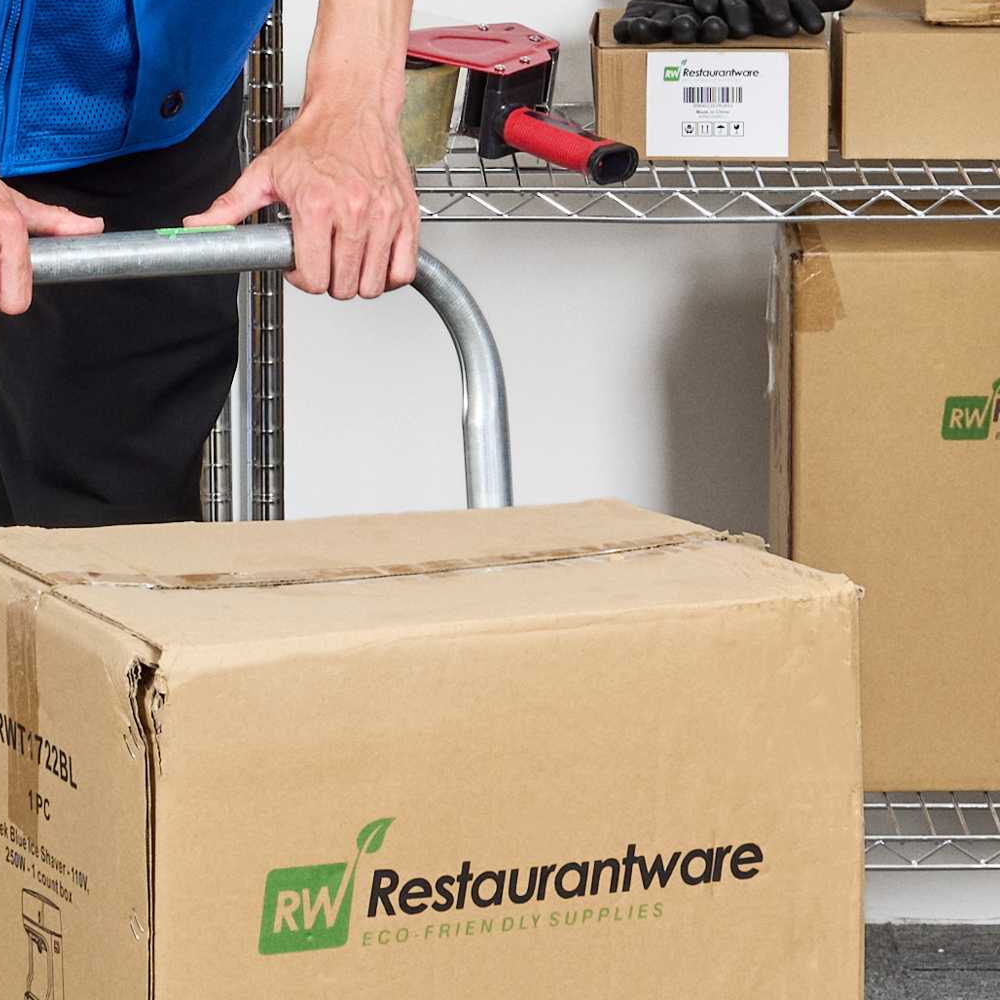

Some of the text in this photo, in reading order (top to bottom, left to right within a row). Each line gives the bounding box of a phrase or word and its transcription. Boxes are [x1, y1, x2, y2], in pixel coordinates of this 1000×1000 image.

[664, 67, 760, 79] RW Restaurantware
[949, 407, 985, 429] RW
[40, 845, 66, 876] Shaver
[273, 842, 764, 934] RW Restaurantware
[549, 902, 665, 928] SUPPLIES
